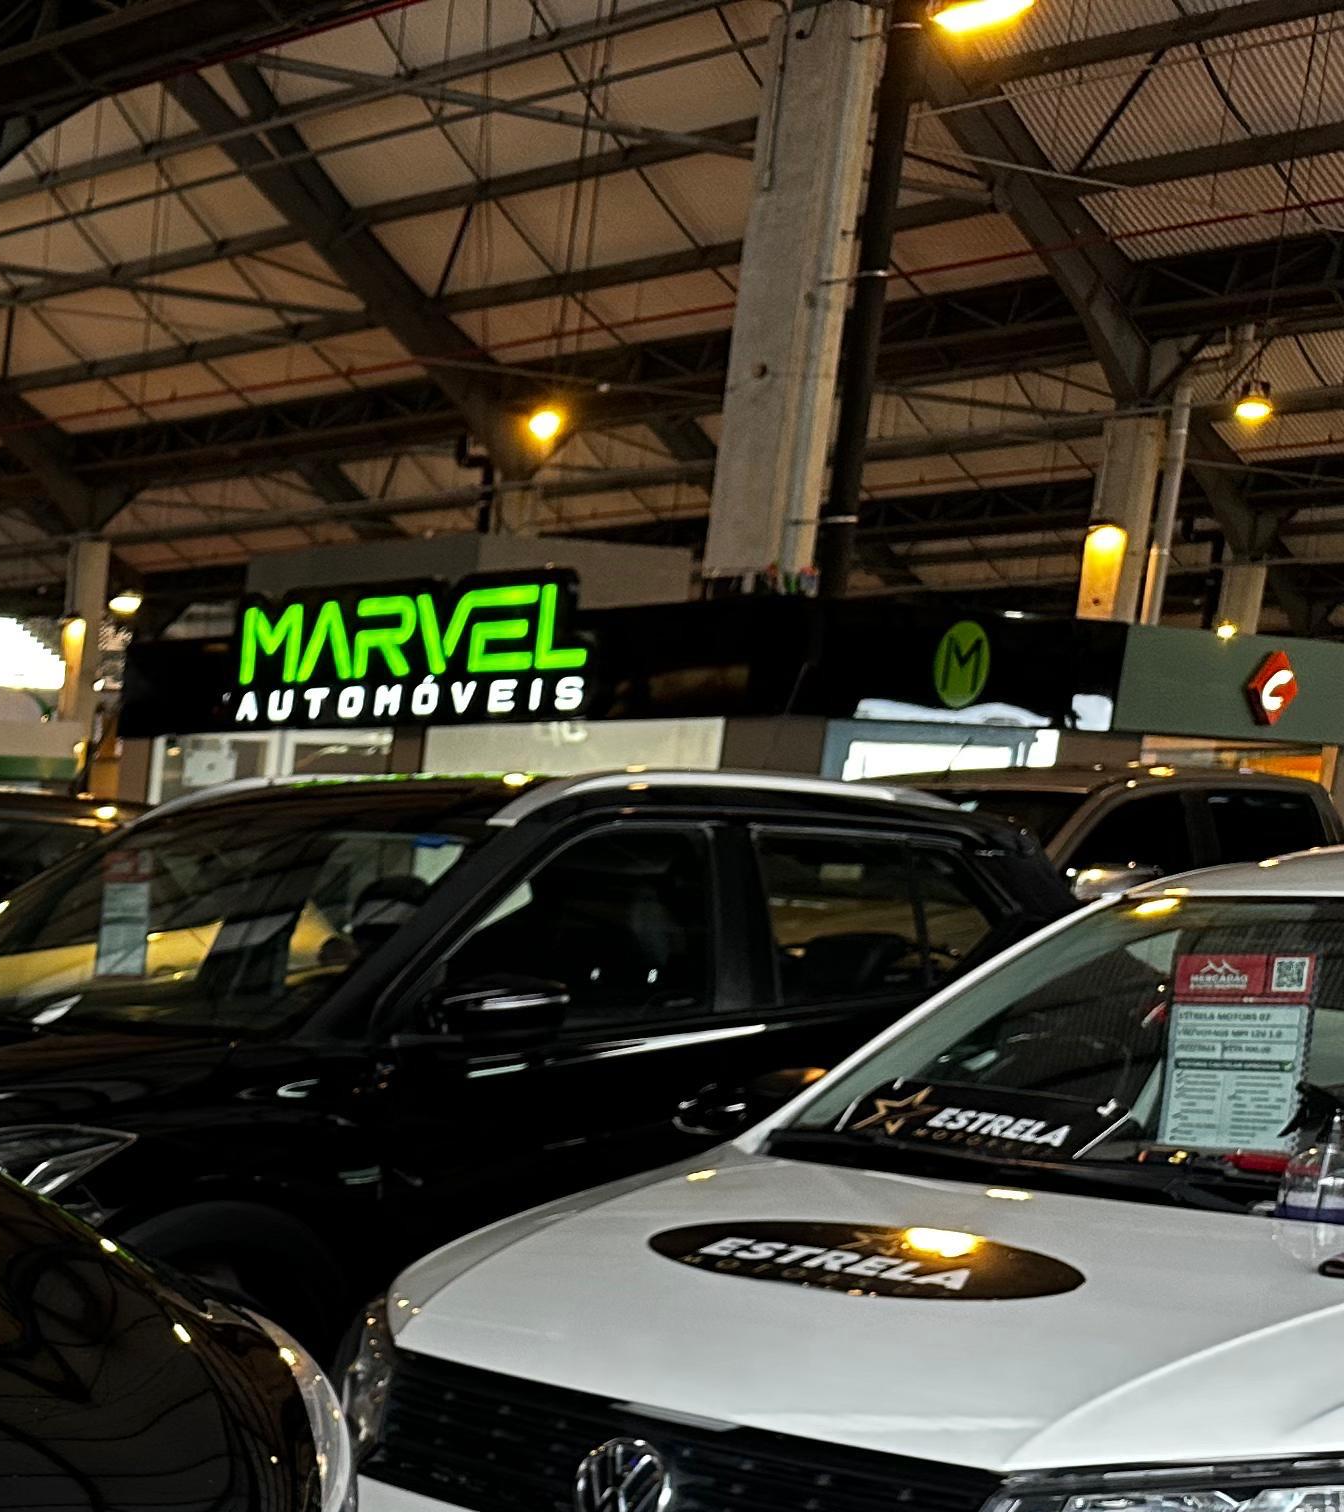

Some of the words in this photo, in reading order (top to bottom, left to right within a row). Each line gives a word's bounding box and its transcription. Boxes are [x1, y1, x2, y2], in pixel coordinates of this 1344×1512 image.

[237, 582, 589, 686] MARVEL
[234, 673, 587, 722] AUTOMÓVEIS
[924, 1106, 1073, 1148] ESTRELA
[698, 1235, 973, 1291] ESTRELA
